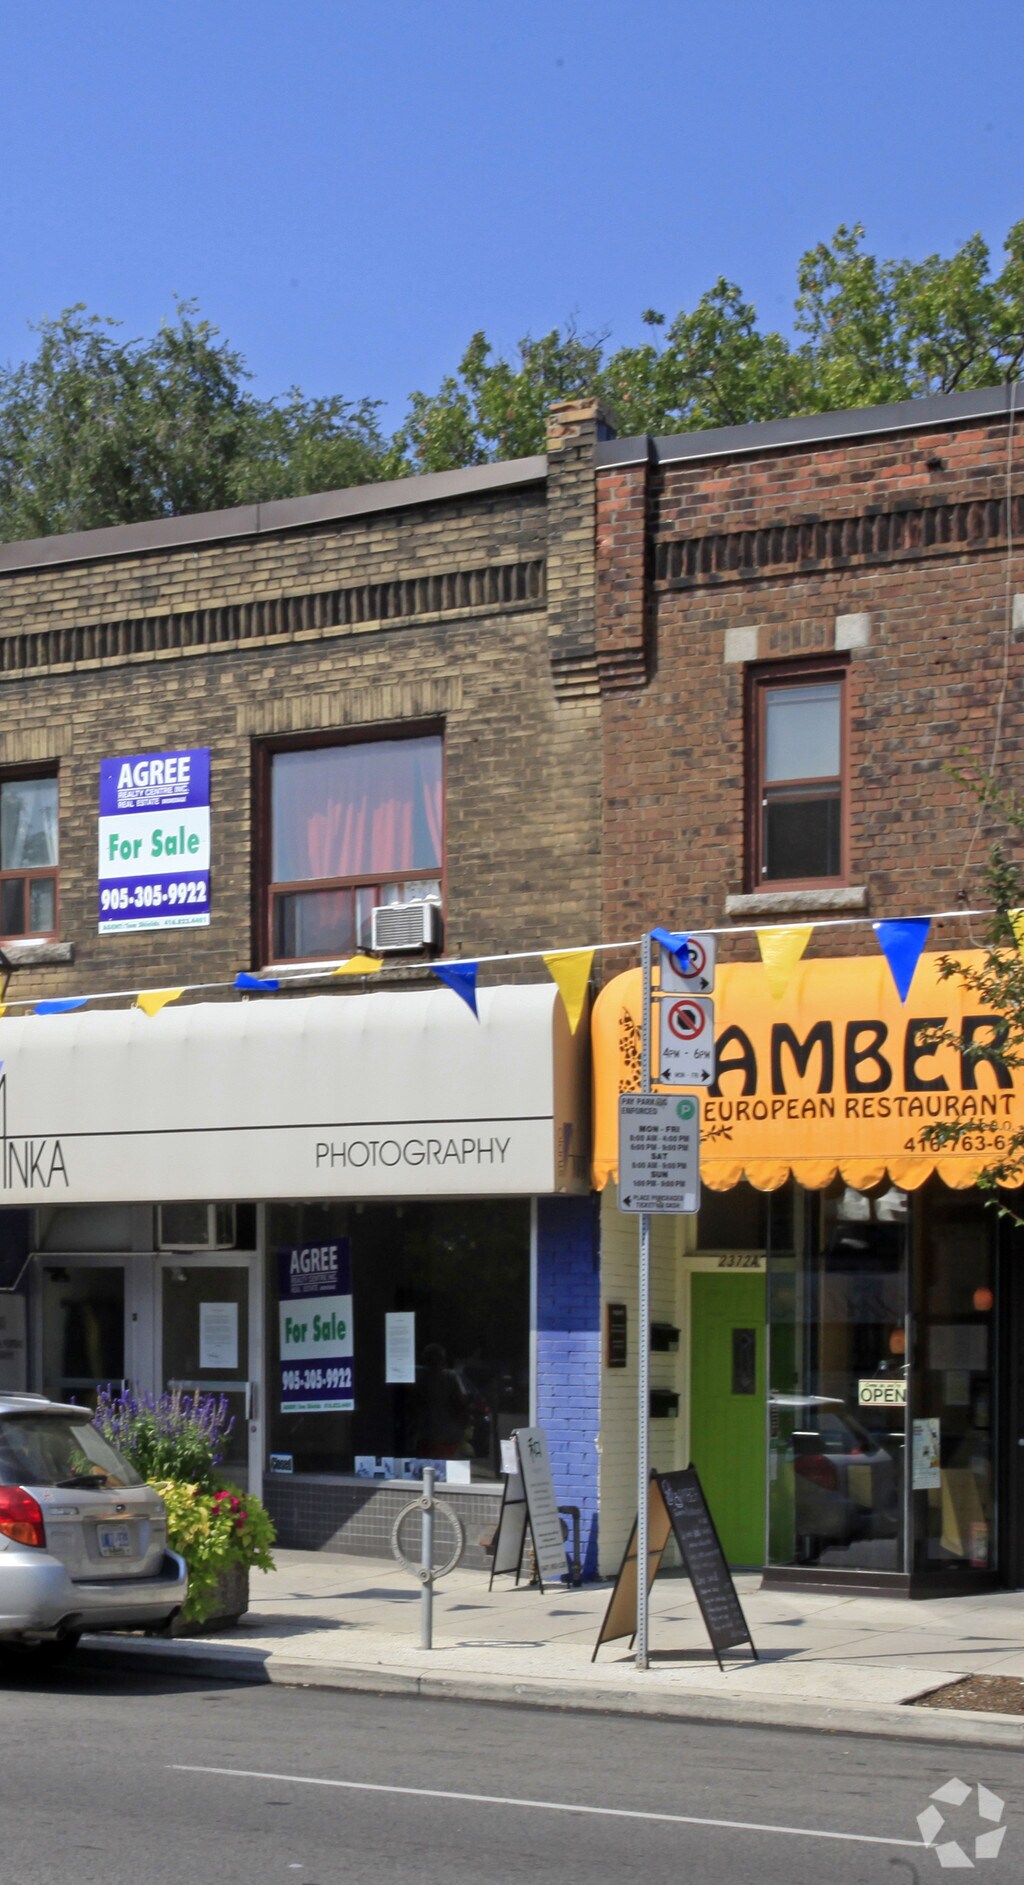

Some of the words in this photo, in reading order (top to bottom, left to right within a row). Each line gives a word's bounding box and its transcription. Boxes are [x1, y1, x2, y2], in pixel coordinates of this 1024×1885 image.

[117, 756, 191, 789] AGREE
[109, 833, 143, 861] For
[151, 825, 200, 858] Sale
[663, 1047, 680, 1058] 4PM
[693, 1048, 711, 1059] 6PM
[706, 1014, 1014, 1097] AMBER
[704, 1098, 835, 1122] EUROPEAN
[845, 1094, 1016, 1119] RESTAURANT
[639, 1125, 658, 1133] MON
[665, 1125, 680, 1133] FRI
[316, 1137, 511, 1168] PHOTOGRAPHY
[651, 1152, 668, 1160] SAT
[290, 1246, 338, 1275] AGREE
[718, 1254, 761, 1268] 2372A
[285, 1316, 308, 1344] For
[313, 1312, 346, 1342] Sale
[860, 1388, 906, 1402] OPEN
